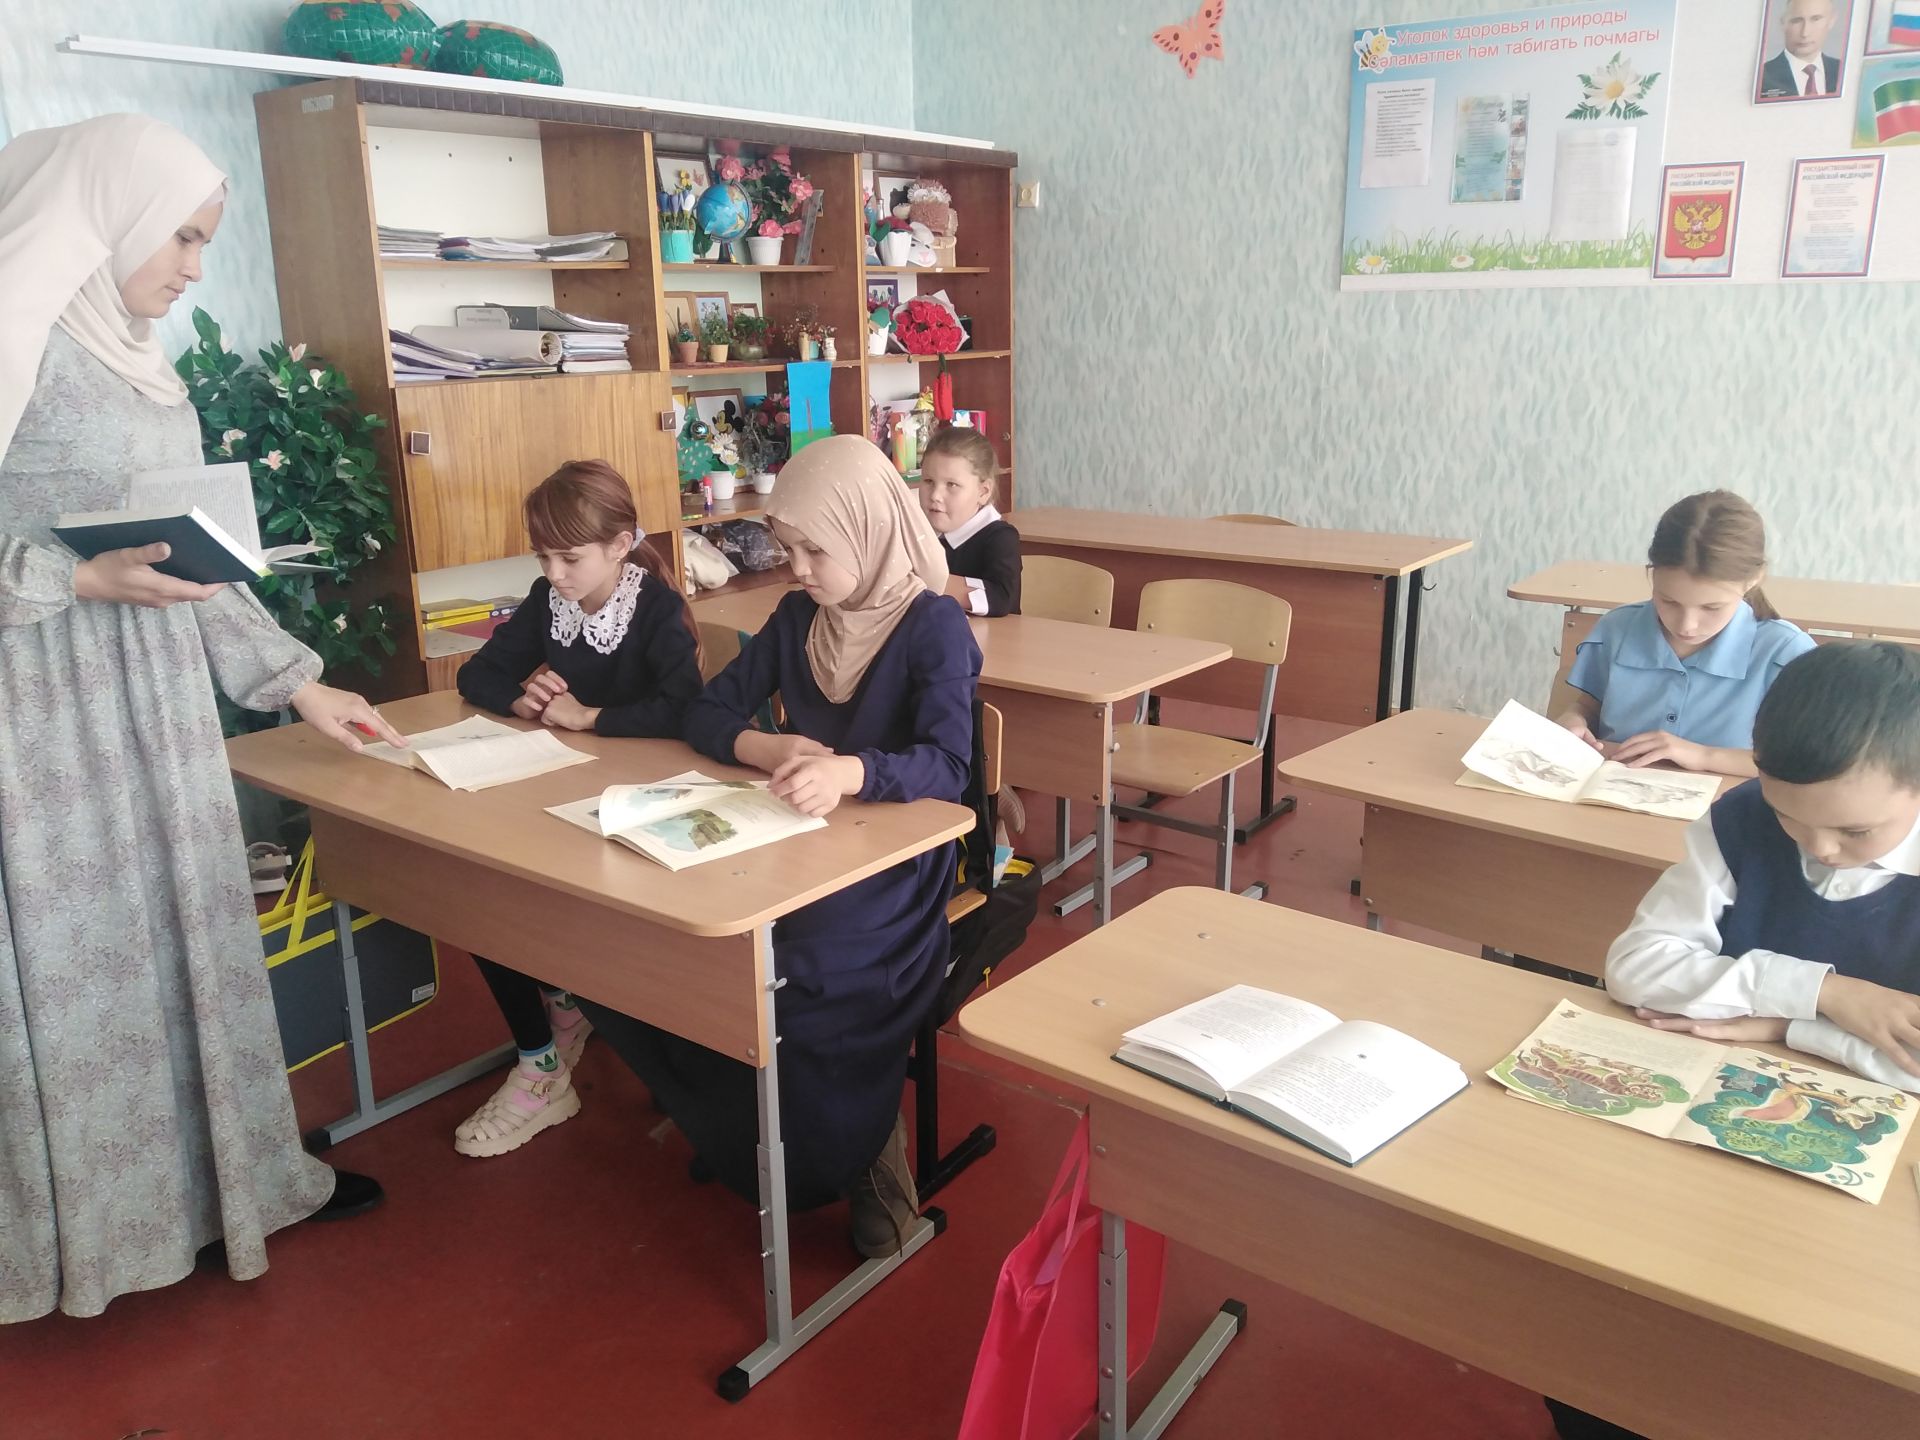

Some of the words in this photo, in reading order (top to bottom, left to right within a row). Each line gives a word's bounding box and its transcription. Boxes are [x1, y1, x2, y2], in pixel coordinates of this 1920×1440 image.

[1397, 28, 1448, 46] Уголок
[1454, 20, 1529, 40] здоровья
[1535, 18, 1545, 30] и
[1550, 9, 1628, 31] природы
[1505, 36, 1578, 55] табигать
[1584, 28, 1660, 47] почмагы
